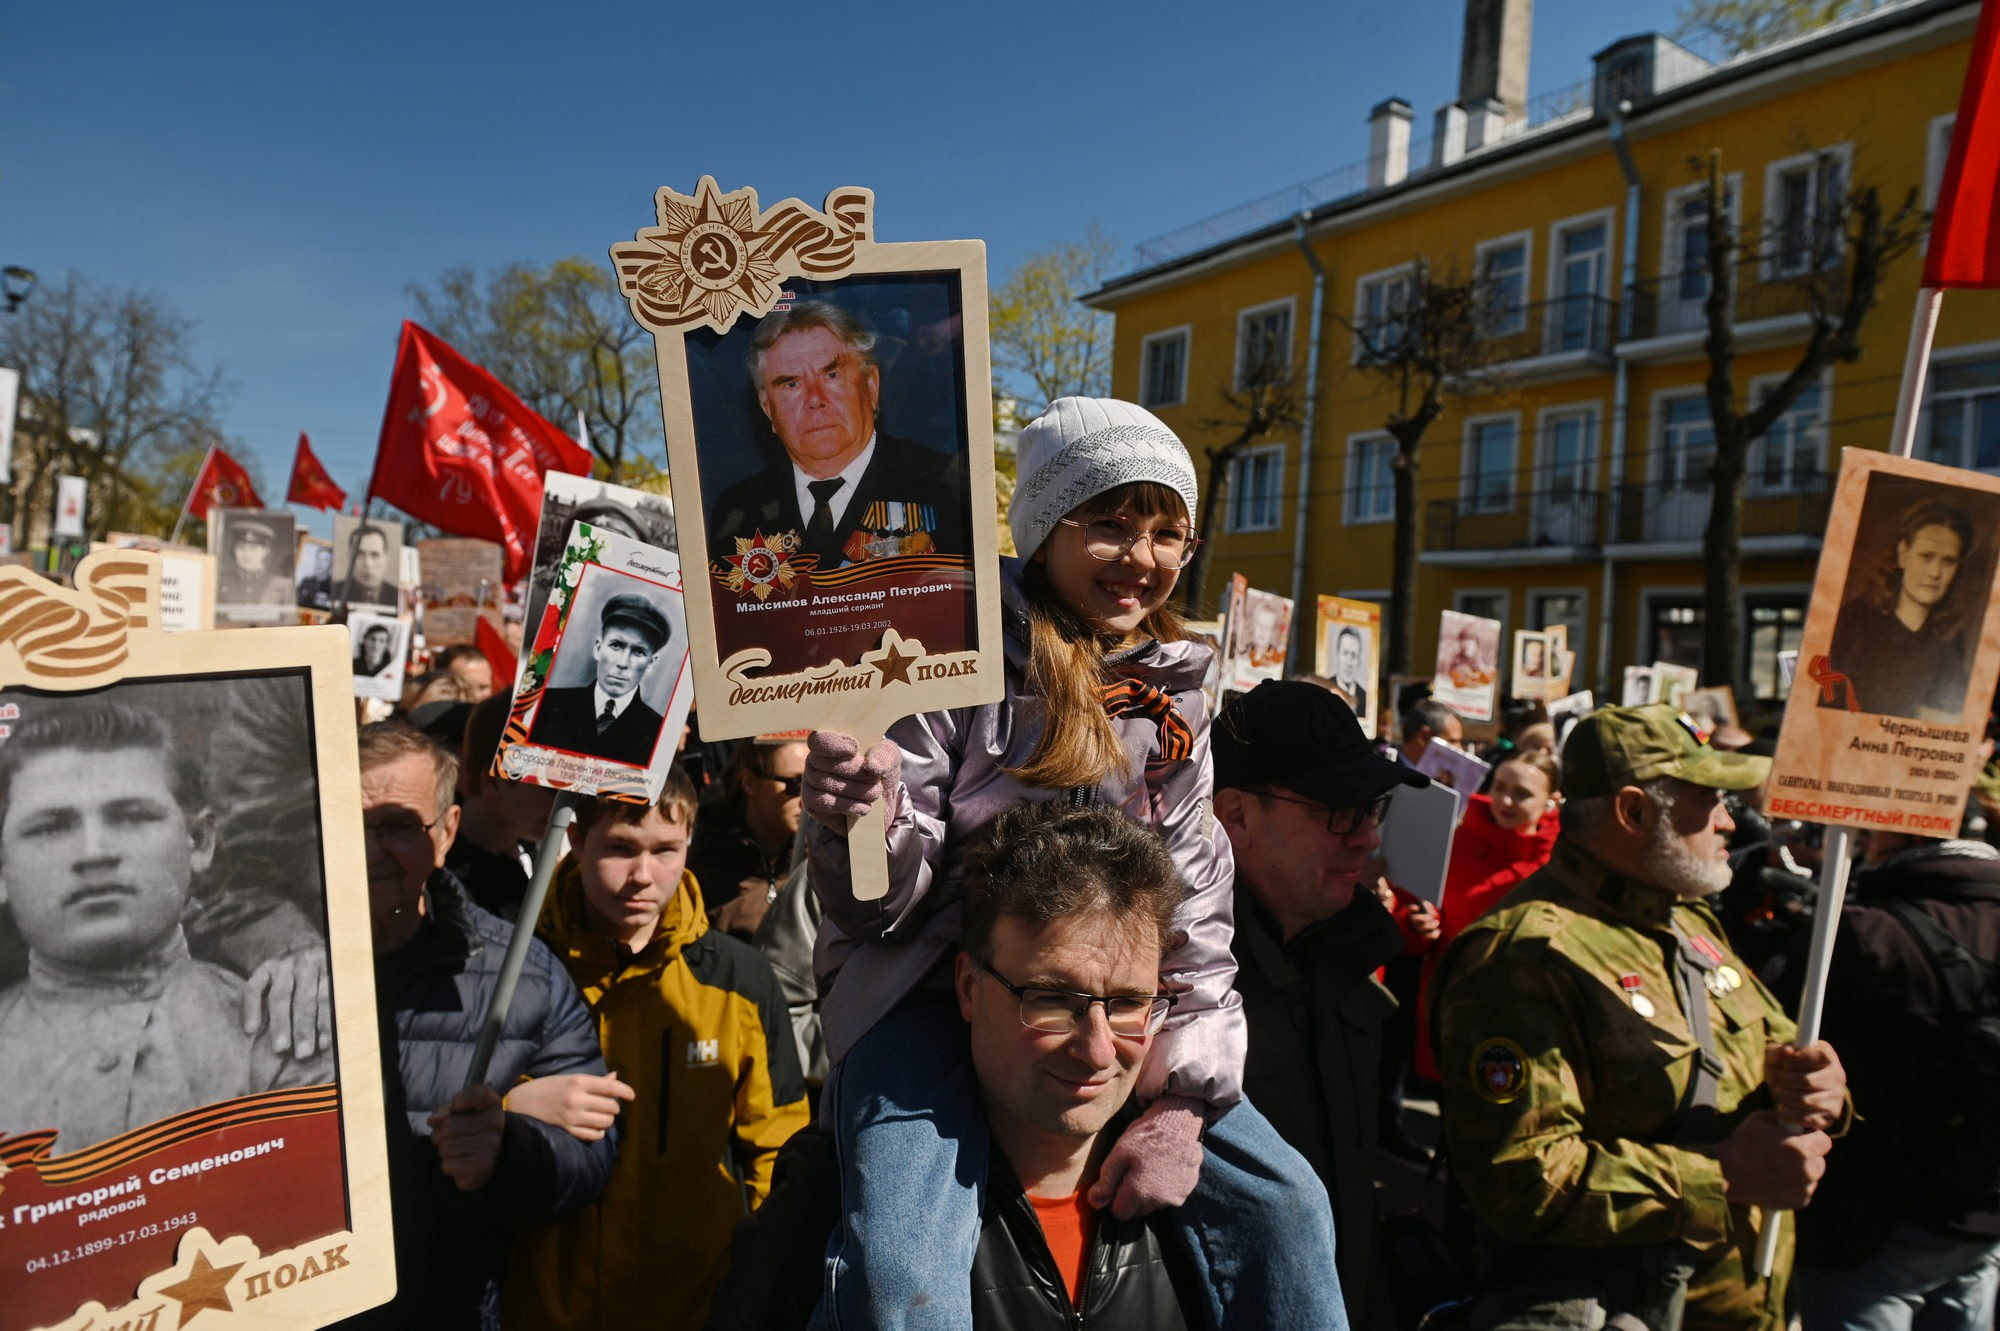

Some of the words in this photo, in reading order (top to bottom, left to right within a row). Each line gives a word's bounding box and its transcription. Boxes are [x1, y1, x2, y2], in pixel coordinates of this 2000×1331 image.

[682, 224, 740, 284] ОТЕЧЕСТВЕННАЯ
[736, 598, 808, 613] Максимов
[812, 589, 886, 606] Александр
[889, 583, 952, 598] Петрович
[809, 605, 849, 617] младший
[851, 602, 885, 613] сержант
[804, 620, 892, 637] 06.01.1926-19.03.2002
[726, 658, 876, 707] бессмертный
[1850, 737, 1889, 754] Анна
[1879, 718, 1970, 743] Чернышева
[511, 750, 556, 768] Огородов
[1770, 798, 1904, 825] БЕССМЕРТНЫЙ
[1908, 813, 1953, 831] ПОЛК
[687, 1039, 718, 1061] HH
[13, 1175, 142, 1225] Григорий
[149, 1137, 285, 1185] Семенович
[78, 1195, 147, 1227] рядовой
[26, 1211, 198, 1273] 04.12.1899-17.03.1943
